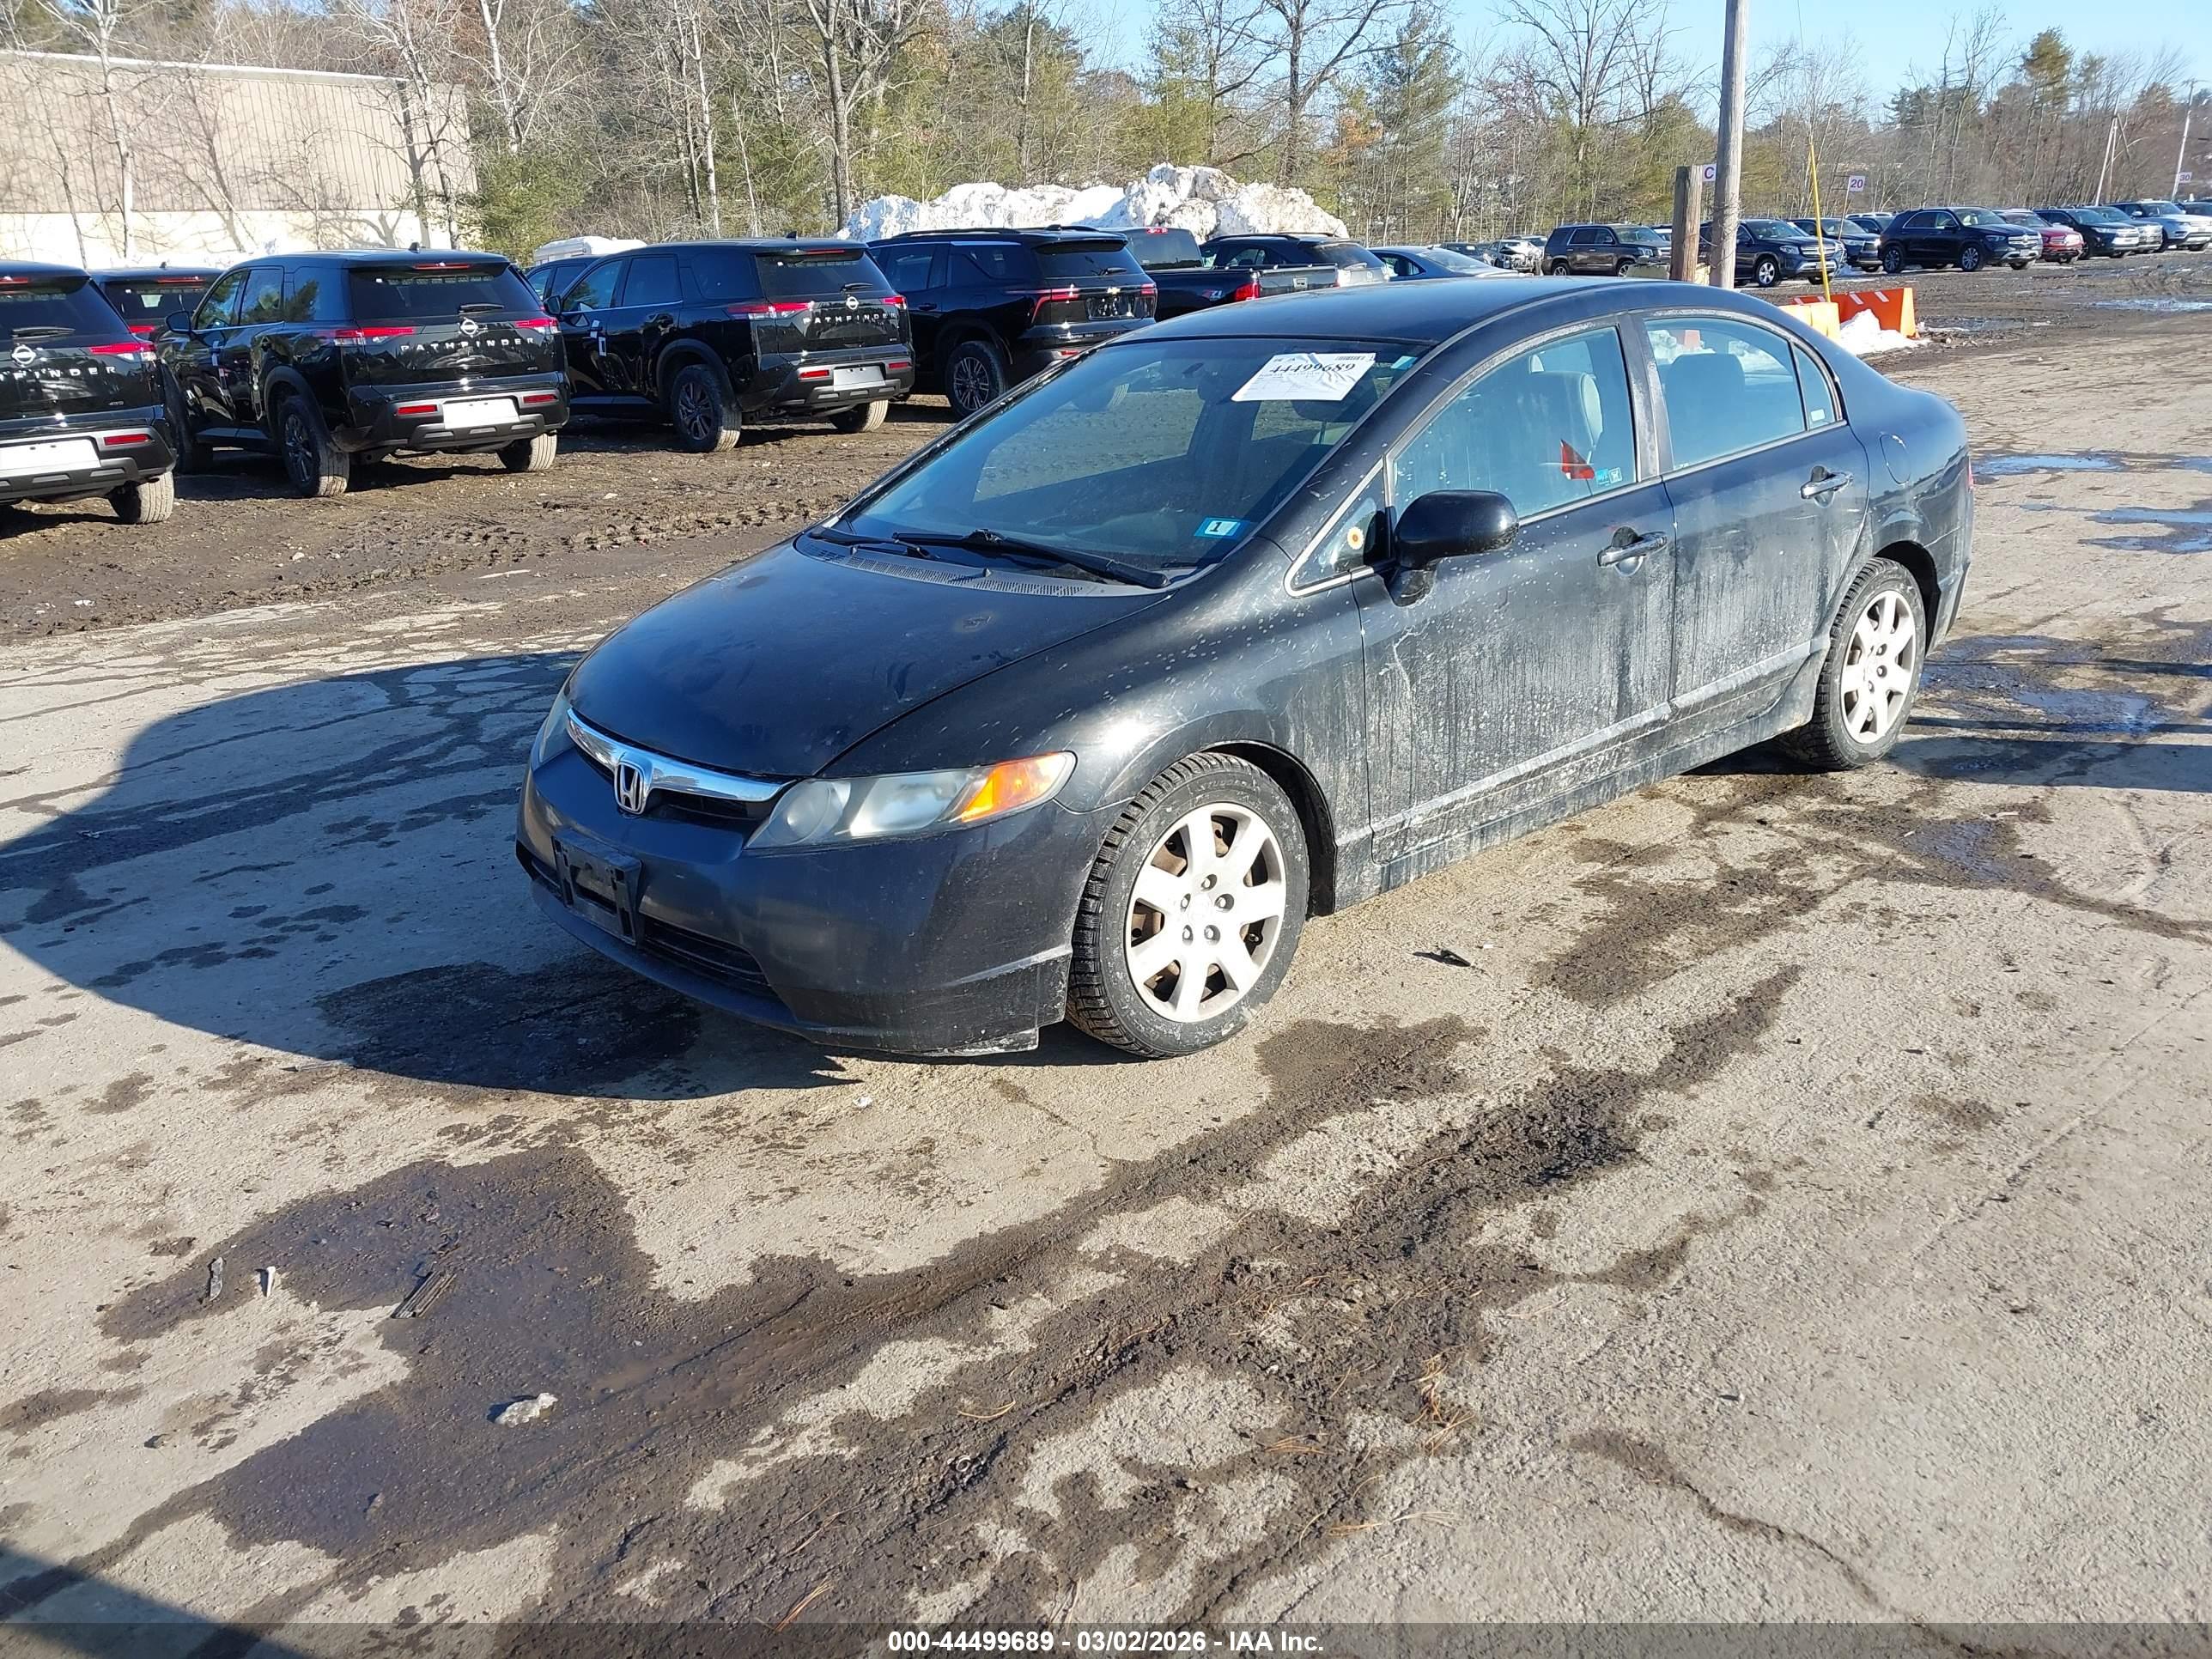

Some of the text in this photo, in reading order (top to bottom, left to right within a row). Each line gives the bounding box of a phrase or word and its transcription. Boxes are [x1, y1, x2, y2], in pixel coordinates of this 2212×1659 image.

[1704, 167, 1714, 179] C
[1850, 179, 1863, 188] 20
[803, 313, 896, 325] PATHFINDER
[400, 337, 534, 351] PATHFINDER
[1270, 363, 1356, 373] 44499689
[1210, 522, 1222, 532] 1
